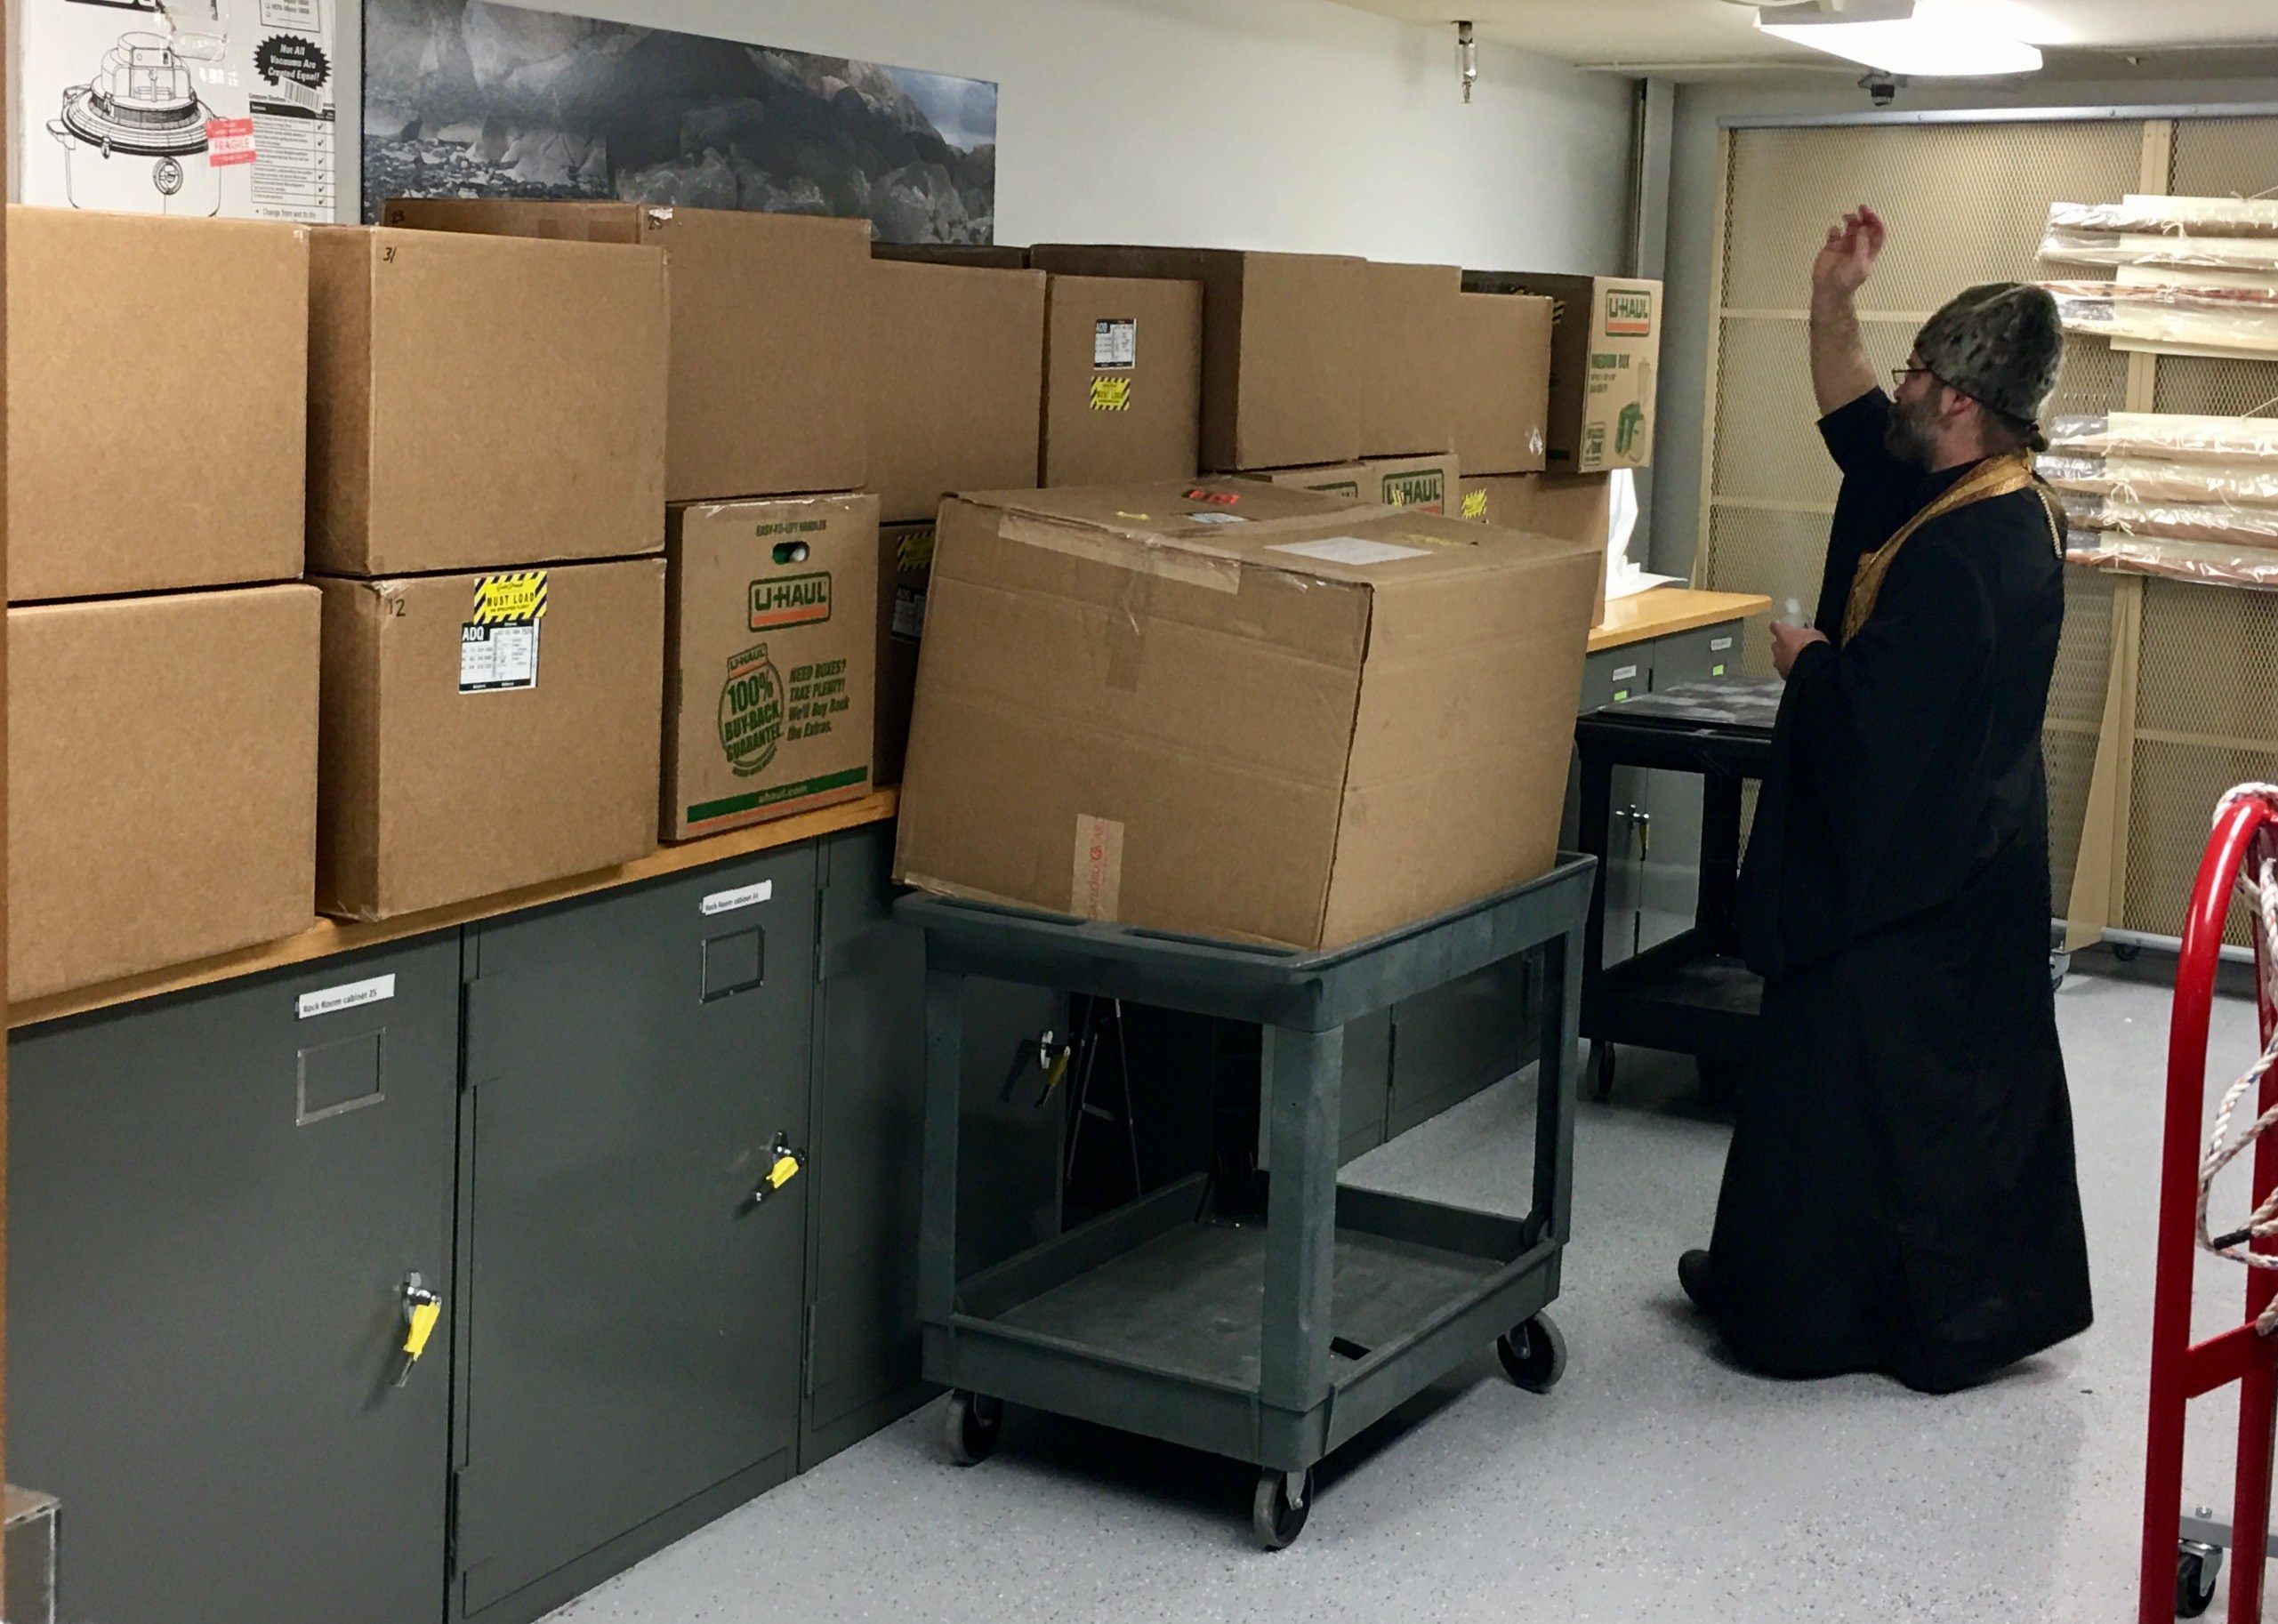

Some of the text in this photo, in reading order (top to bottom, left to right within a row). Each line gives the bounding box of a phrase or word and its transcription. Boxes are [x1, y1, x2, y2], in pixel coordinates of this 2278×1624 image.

[280, 44, 305, 55] Not All
[303, 60, 316, 68] Are
[214, 139, 250, 150] FRAGILE
[1608, 297, 1648, 319] U-HAUL
[487, 592, 535, 607] MUST LOAD
[755, 582, 827, 611] U-HAUL
[388, 599, 406, 616] 12
[463, 626, 484, 640] ADQ
[730, 647, 765, 670] U-HAUL
[789, 665, 813, 684] NEED
[727, 670, 773, 715] 100%
[790, 678, 846, 703] TAKE PLENTY!
[789, 695, 850, 721] We'll Buy Back
[724, 700, 780, 742] BUY-BACK
[726, 721, 782, 762] GUARANTEE
[759, 785, 808, 803] uhaul.com
[303, 1001, 319, 1013] Rock
[322, 998, 342, 1009] Room
[343, 992, 367, 1003] cabinet
